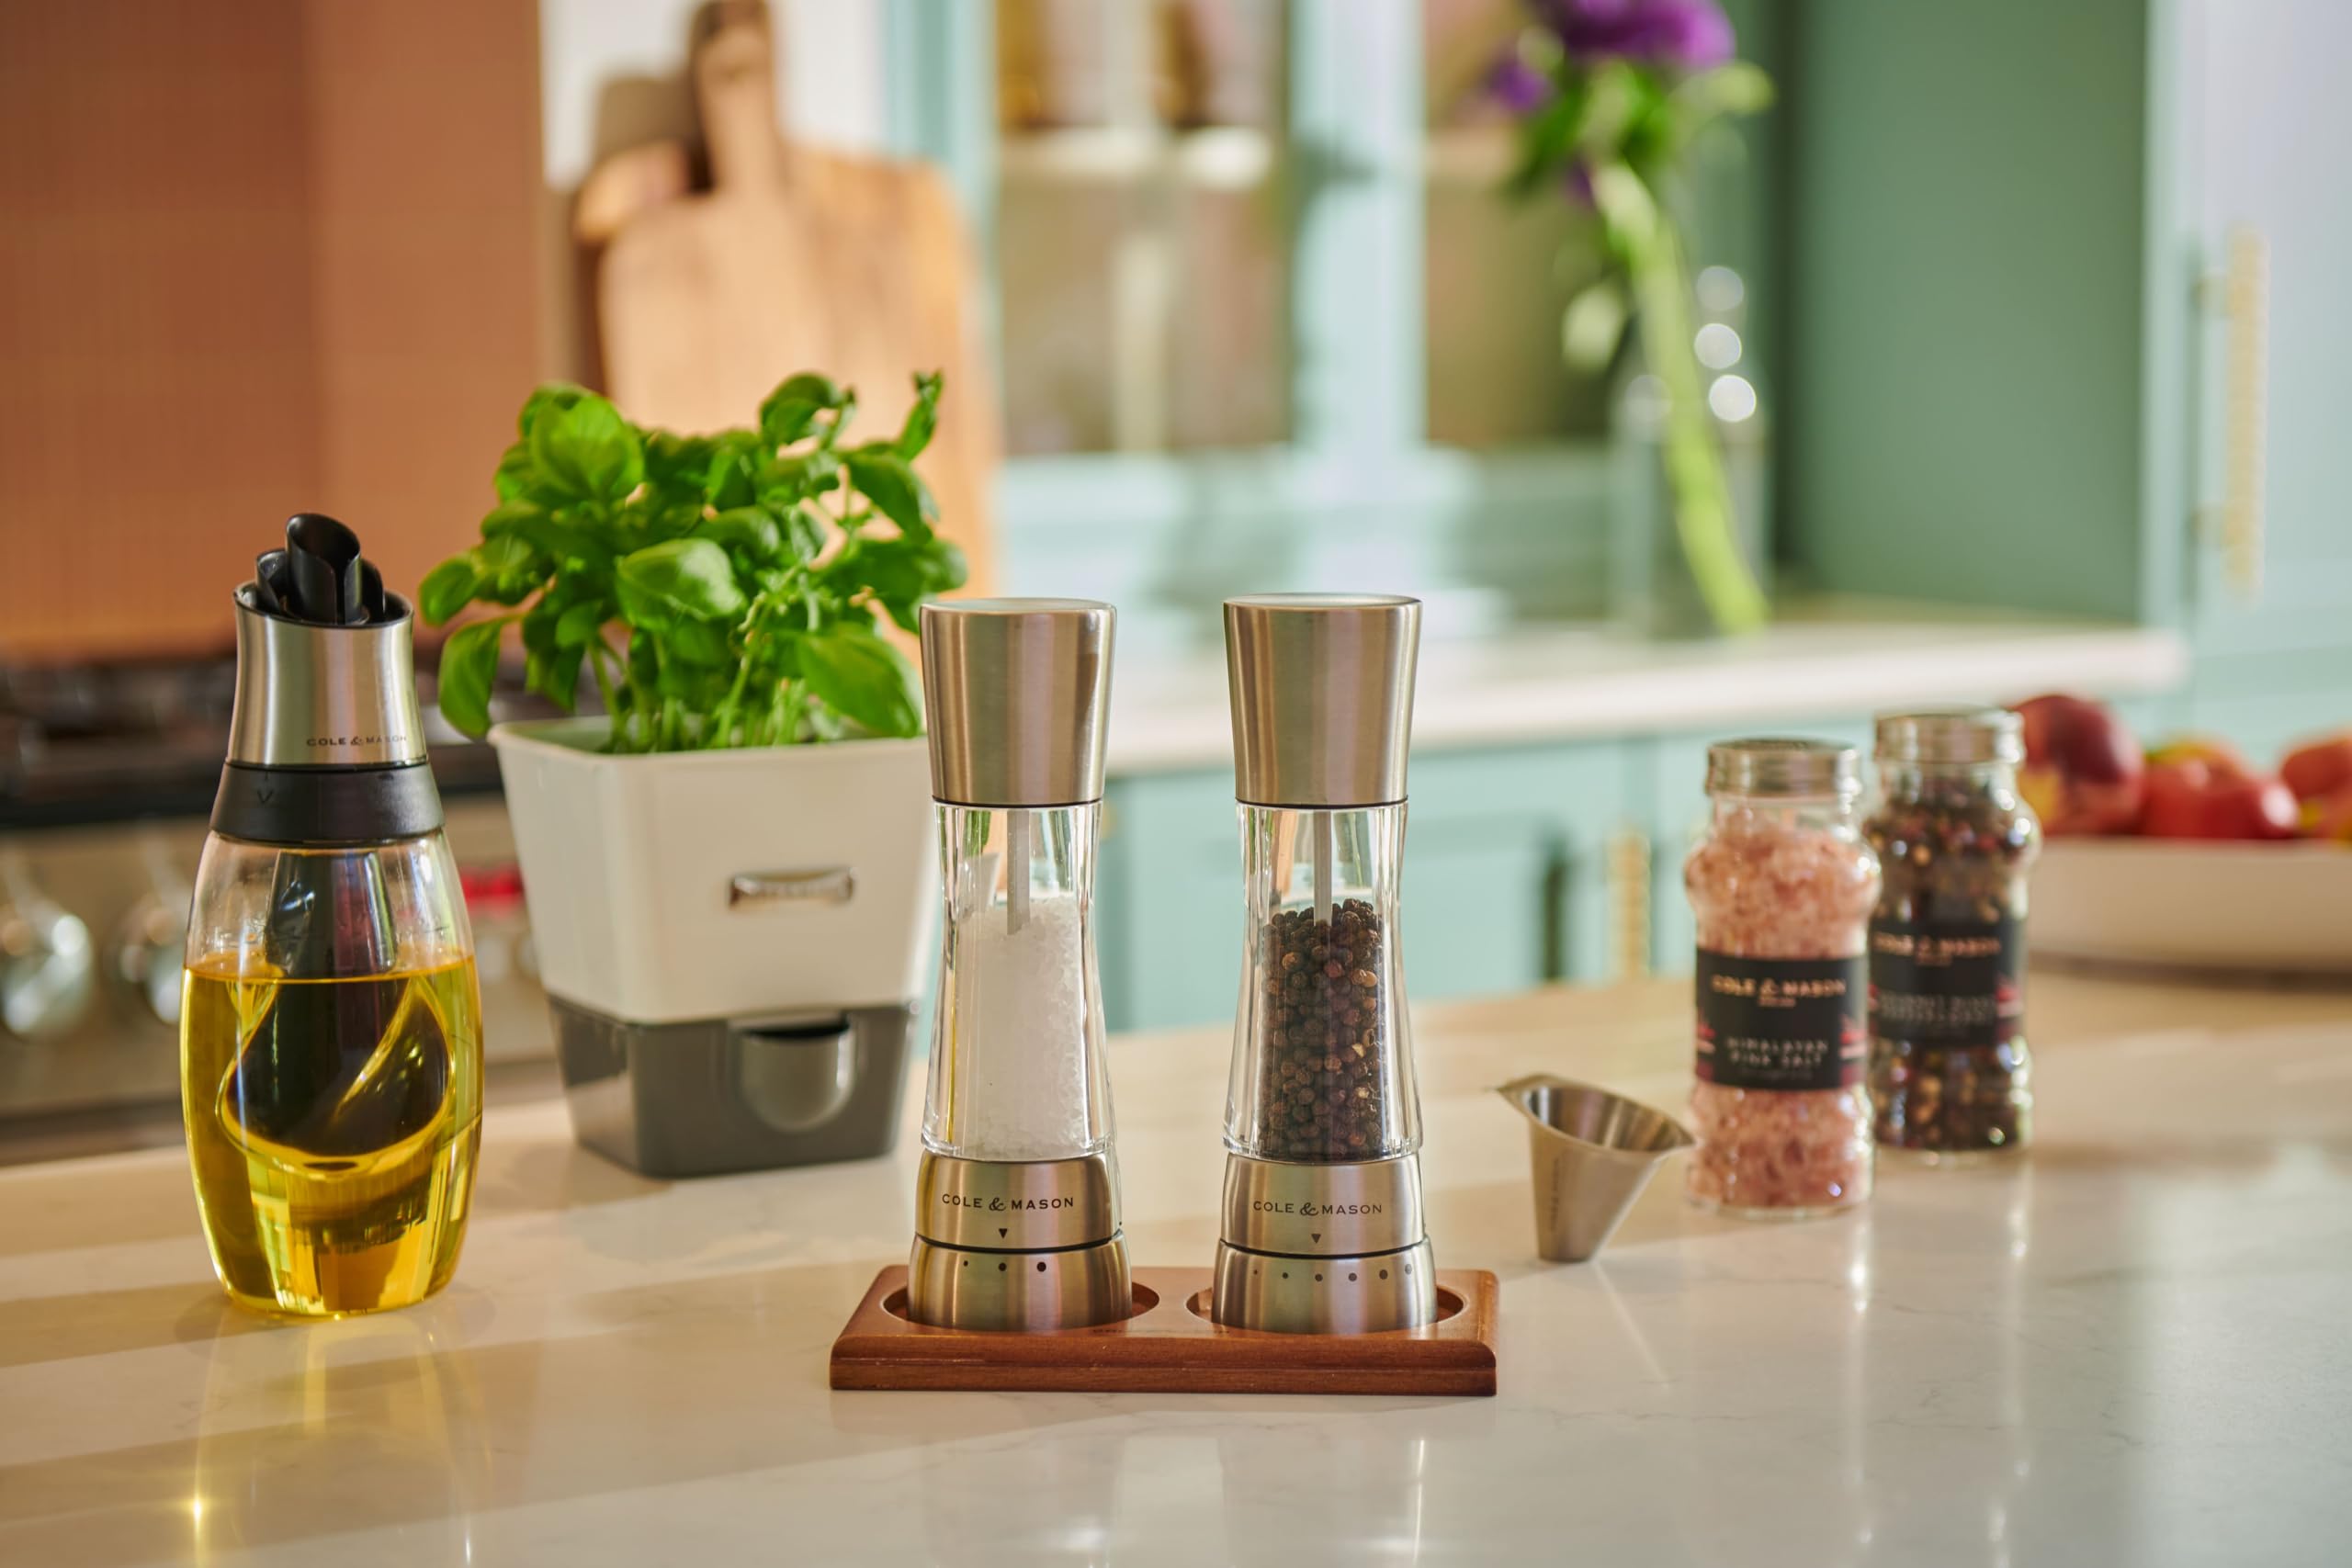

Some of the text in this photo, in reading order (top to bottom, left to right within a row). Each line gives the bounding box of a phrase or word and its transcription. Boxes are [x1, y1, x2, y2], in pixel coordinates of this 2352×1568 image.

[306, 735, 407, 747] COLE & MASON
[1711, 975, 1756, 997] COLE
[1782, 978, 1847, 998] MASON
[1727, 1037, 1828, 1055] HIMALAYAN
[1781, 1053, 1822, 1067] SALT
[942, 1193, 1074, 1212] COLE & MASON
[1253, 1201, 1382, 1217] COLE & MASON
